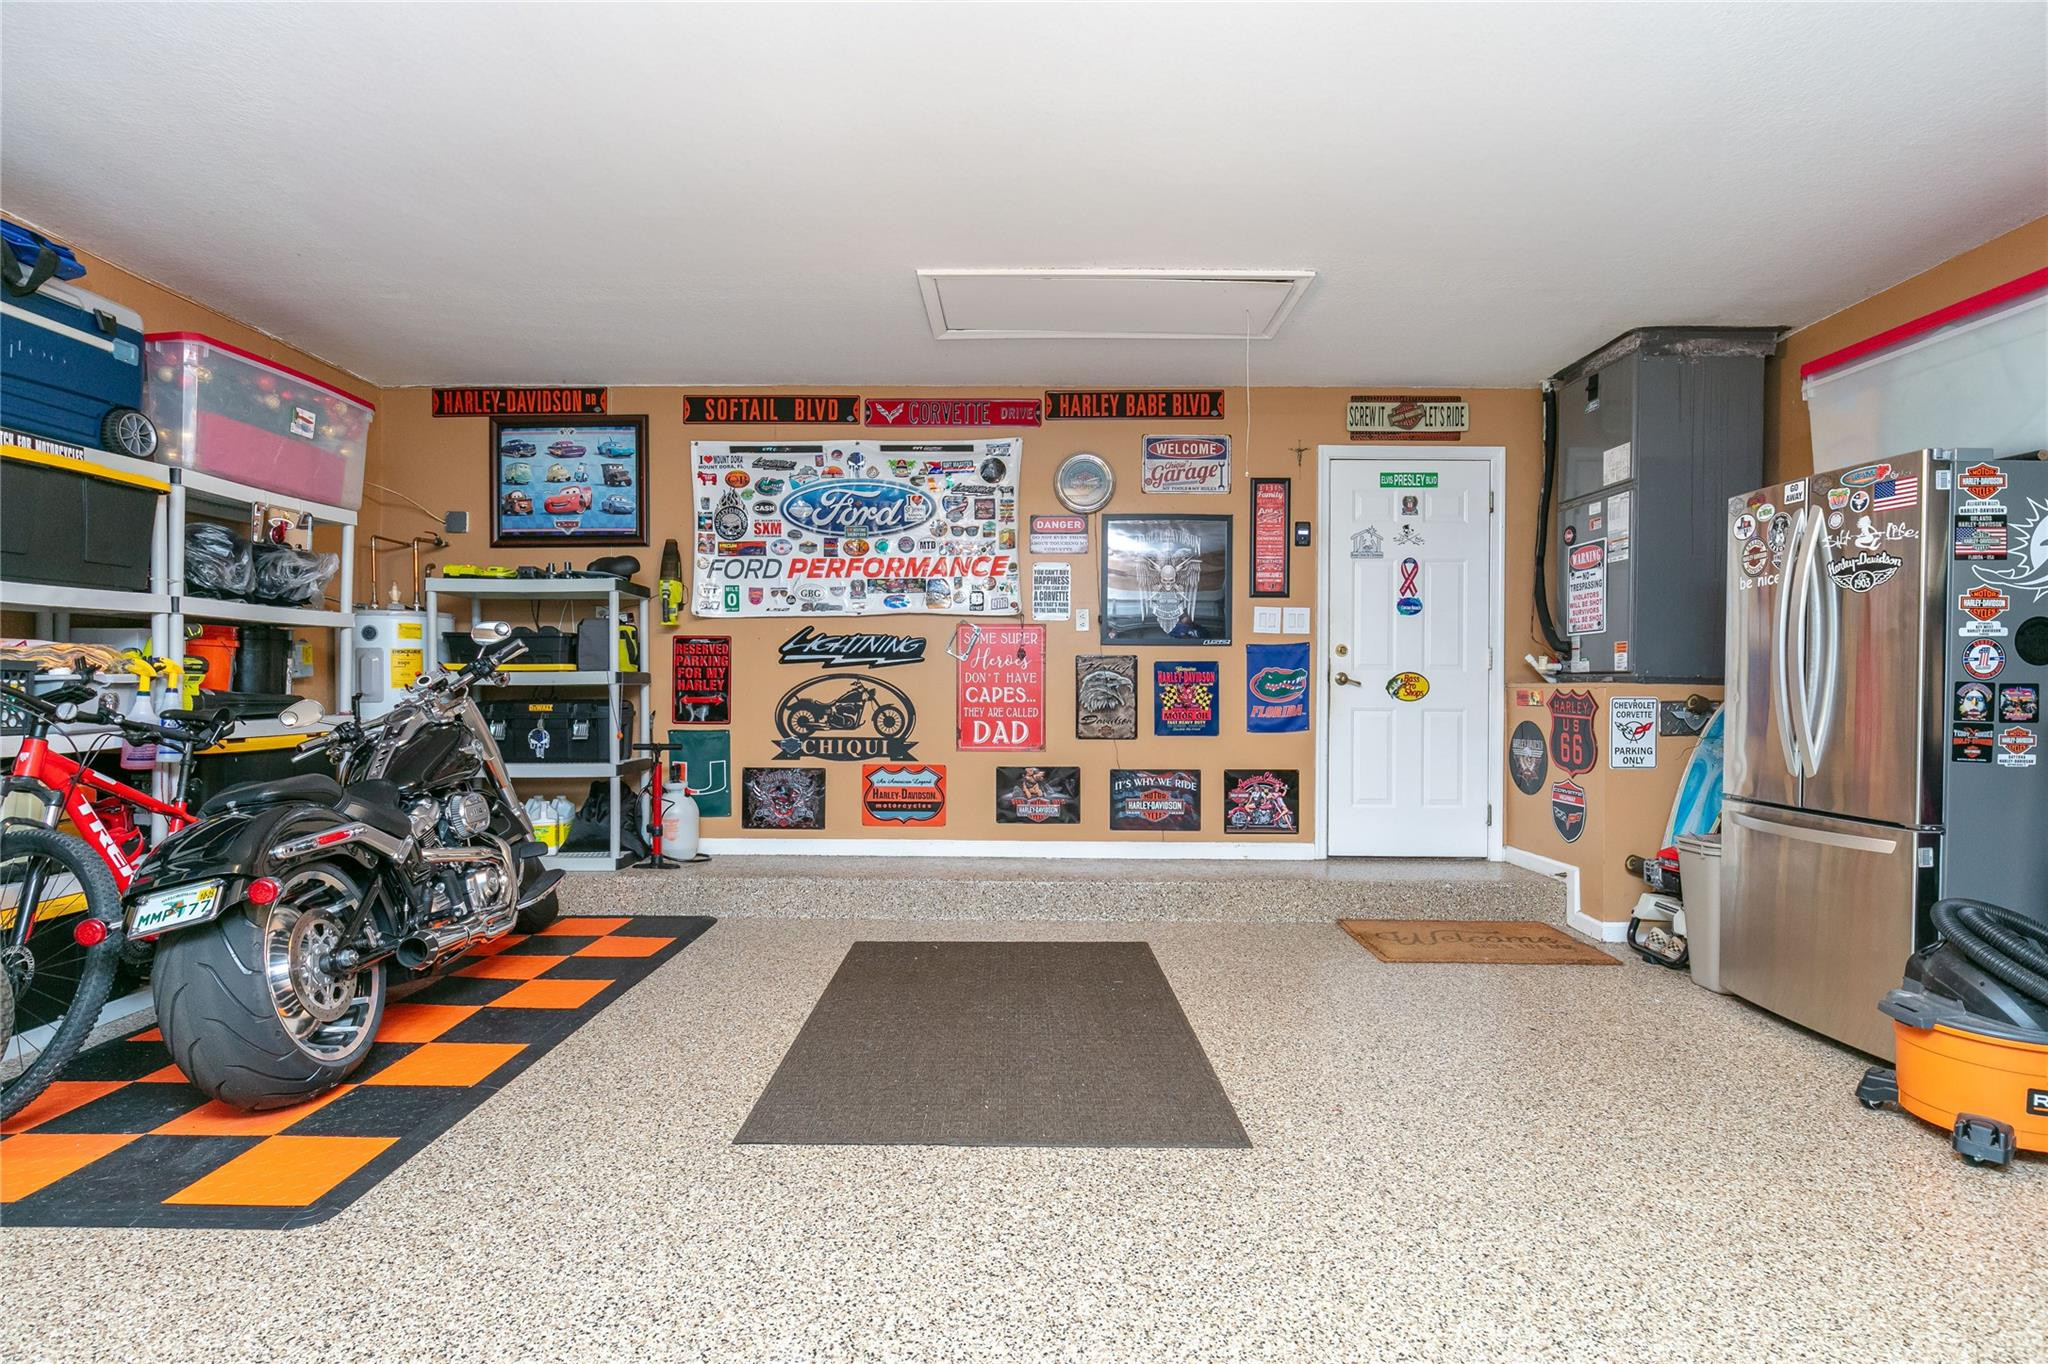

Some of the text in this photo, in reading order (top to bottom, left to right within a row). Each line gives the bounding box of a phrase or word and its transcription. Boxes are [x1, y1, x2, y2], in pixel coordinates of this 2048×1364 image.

[444, 389, 597, 413] HARLEY-DAVIDSON DR
[1059, 393, 1211, 417] HARLEY BABE BLVD
[704, 398, 839, 422] SOFTAIL BLVD
[908, 400, 1034, 424] CORVETTE DRIVE
[1349, 406, 1376, 427] SCREW
[1378, 406, 1385, 427] IT
[1424, 406, 1445, 427] LET'S
[1446, 406, 1465, 427] RIDE
[1156, 443, 1216, 455] WELCOME
[1151, 464, 1219, 489] Garage
[1972, 467, 1994, 475] MOTOR
[1393, 474, 1425, 486] PRESLEY
[1789, 483, 1799, 493] GO
[1972, 487, 1994, 496] CYCLES
[1785, 492, 1803, 502] AWAY
[812, 489, 905, 526] Ford
[753, 523, 782, 535] SXM
[1036, 520, 1082, 529] DANGER
[1572, 548, 1601, 565] WARNING
[706, 555, 1010, 579] FORD PERFORMANCE
[1827, 552, 1902, 576] Harley-Davidson
[1033, 576, 1070, 585] HAPPINESS
[1570, 579, 1602, 592] TRESPASSING
[1739, 572, 1781, 590] be nice
[1854, 577, 1871, 589] 1903
[800, 589, 821, 598] GBG
[1033, 591, 1069, 601] A CORVETTE
[1572, 591, 1600, 601] VIOLATORS
[1973, 590, 1996, 598] MOTOR
[727, 593, 736, 607] 0
[1581, 600, 1588, 608] BE
[1589, 598, 1602, 606] SHOT
[1572, 606, 1600, 616] SURVIVORS
[1973, 608, 1996, 618] CYCLES
[1588, 614, 1602, 622] SHOT
[784, 626, 924, 653] LIGHTNING
[1000, 632, 1038, 645] SUPER
[676, 643, 729, 655] RESERVED
[675, 655, 729, 667] PARKING
[970, 647, 1030, 670] Heroes
[678, 667, 726, 679] FOR MY
[1007, 673, 1037, 684] HAVE
[1157, 671, 1216, 683] HARLEY-DAVIDSON
[1404, 674, 1420, 683] Bass
[678, 679, 725, 691] HARLEY
[965, 687, 1036, 703] CAPES...
[1403, 689, 1424, 699] Shops
[1250, 704, 1304, 718] FLORIDA
[1553, 700, 1588, 714] HARLEY
[1613, 701, 1655, 709] CHEVROLET
[963, 707, 1039, 717] THEY ARE CALLED
[1163, 711, 1209, 720] MOTOR OIL
[1616, 711, 1653, 719] CORVETTE
[973, 720, 1030, 745] DAD
[802, 739, 889, 756] CHIQUI
[1561, 732, 1582, 765] 66
[1614, 747, 1653, 755] PARKING
[1622, 756, 1645, 765] ONLY
[1115, 779, 1132, 791] IT'S
[1174, 779, 1198, 792] RIDE
[872, 788, 936, 800] HARLEY-DAVIDSON
[1128, 801, 1182, 810] HARLEY-DAVIDSON
